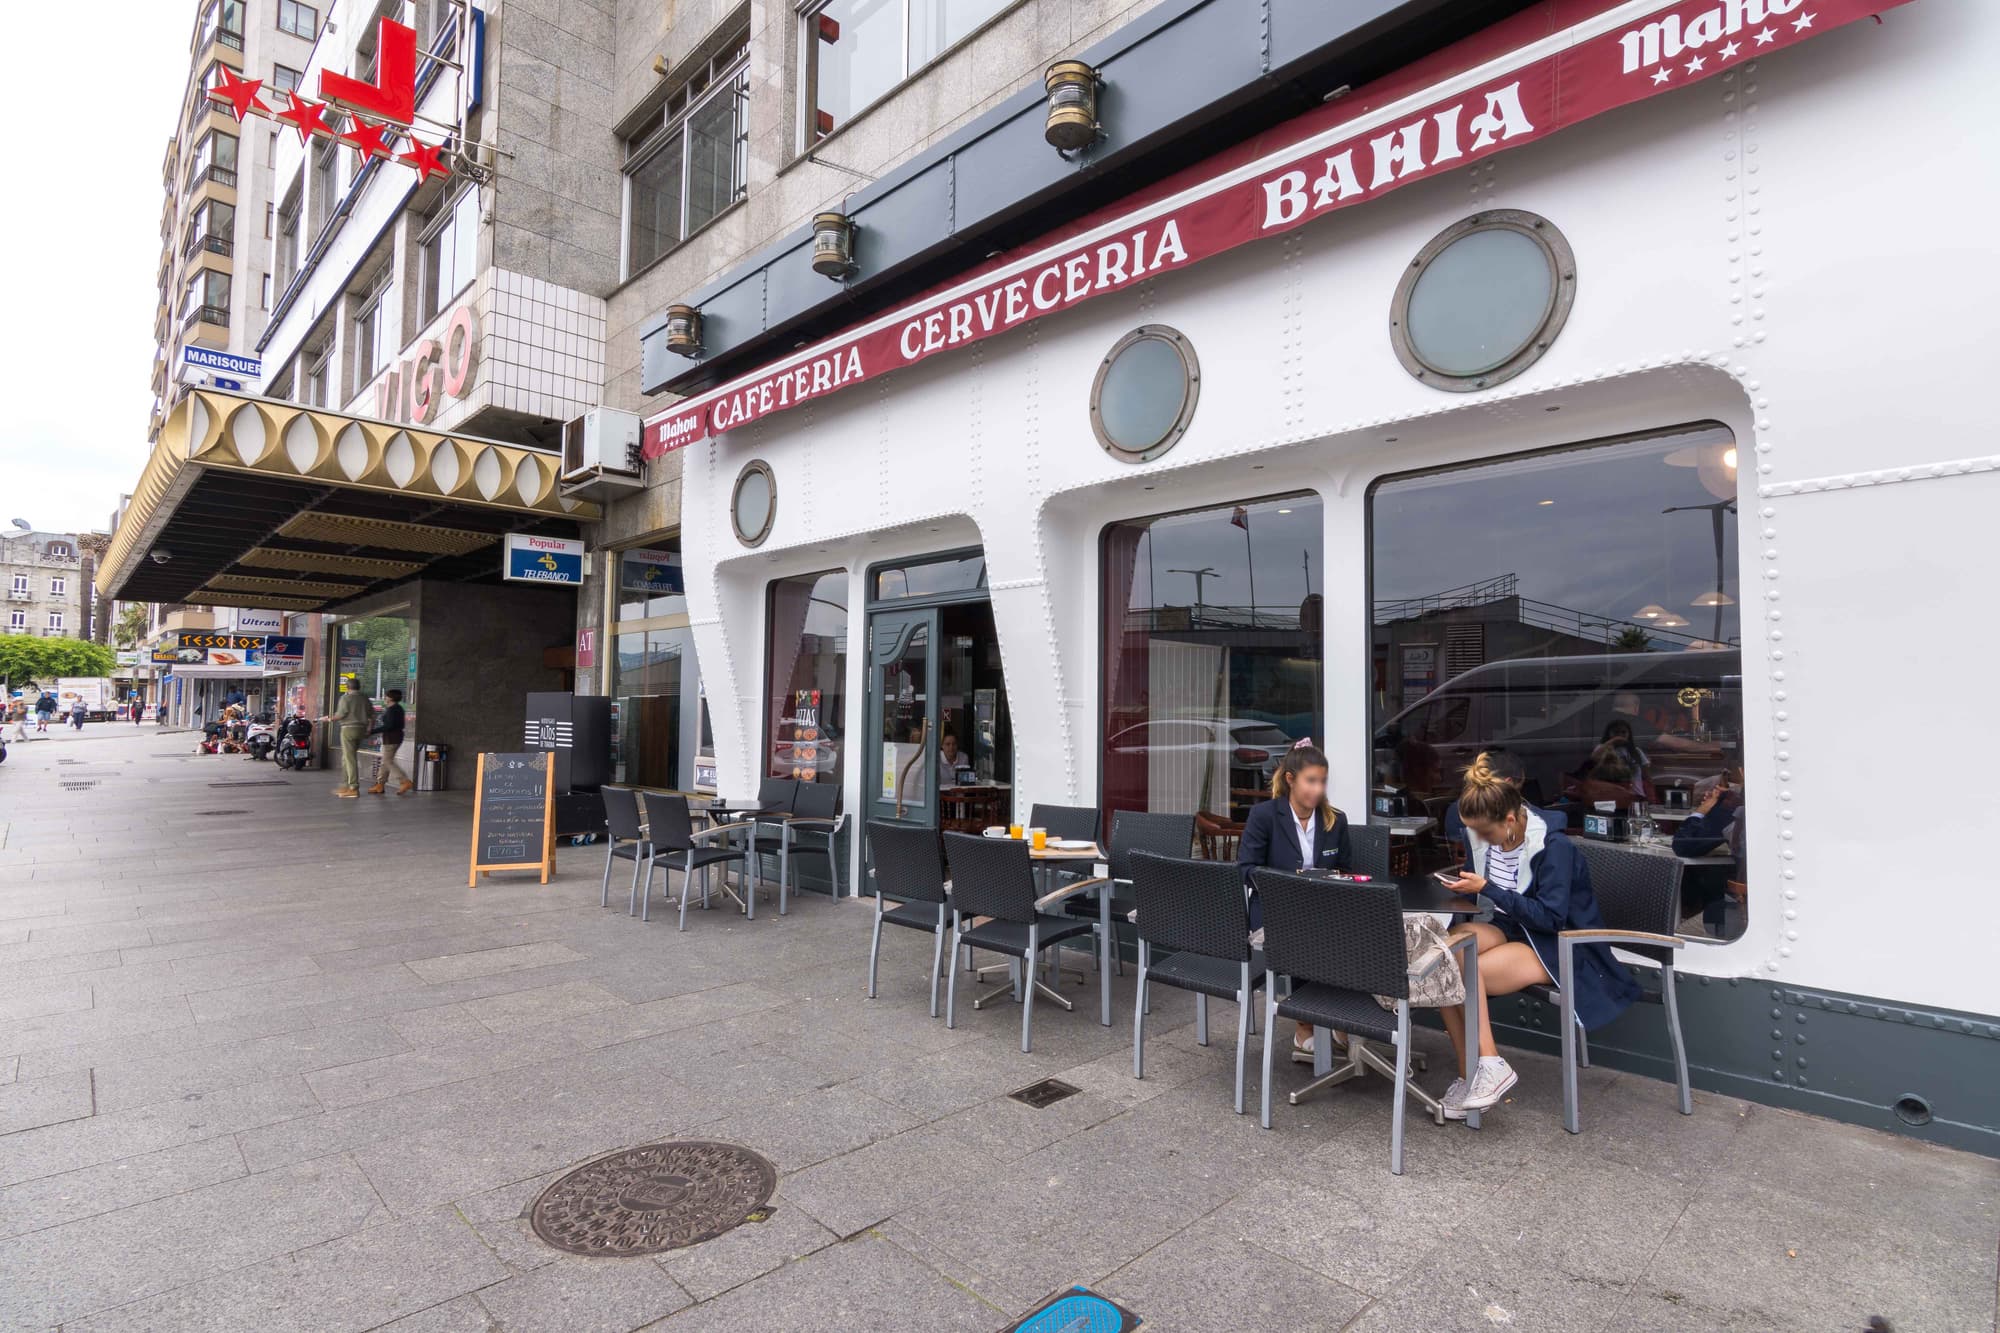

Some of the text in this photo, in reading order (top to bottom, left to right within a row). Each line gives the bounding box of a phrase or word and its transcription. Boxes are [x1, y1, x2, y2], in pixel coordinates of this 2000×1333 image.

[1619, 0, 1801, 74] Mah
[713, 346, 865, 431] CAFETERIA
[899, 219, 1188, 361] CERVECERIA
[1261, 80, 1536, 230] BAHIA
[528, 537, 567, 550] Popular
[523, 568, 570, 582] TELEBANCO
[182, 634, 261, 649] TESOOS
[797, 708, 816, 727] ZZAS
